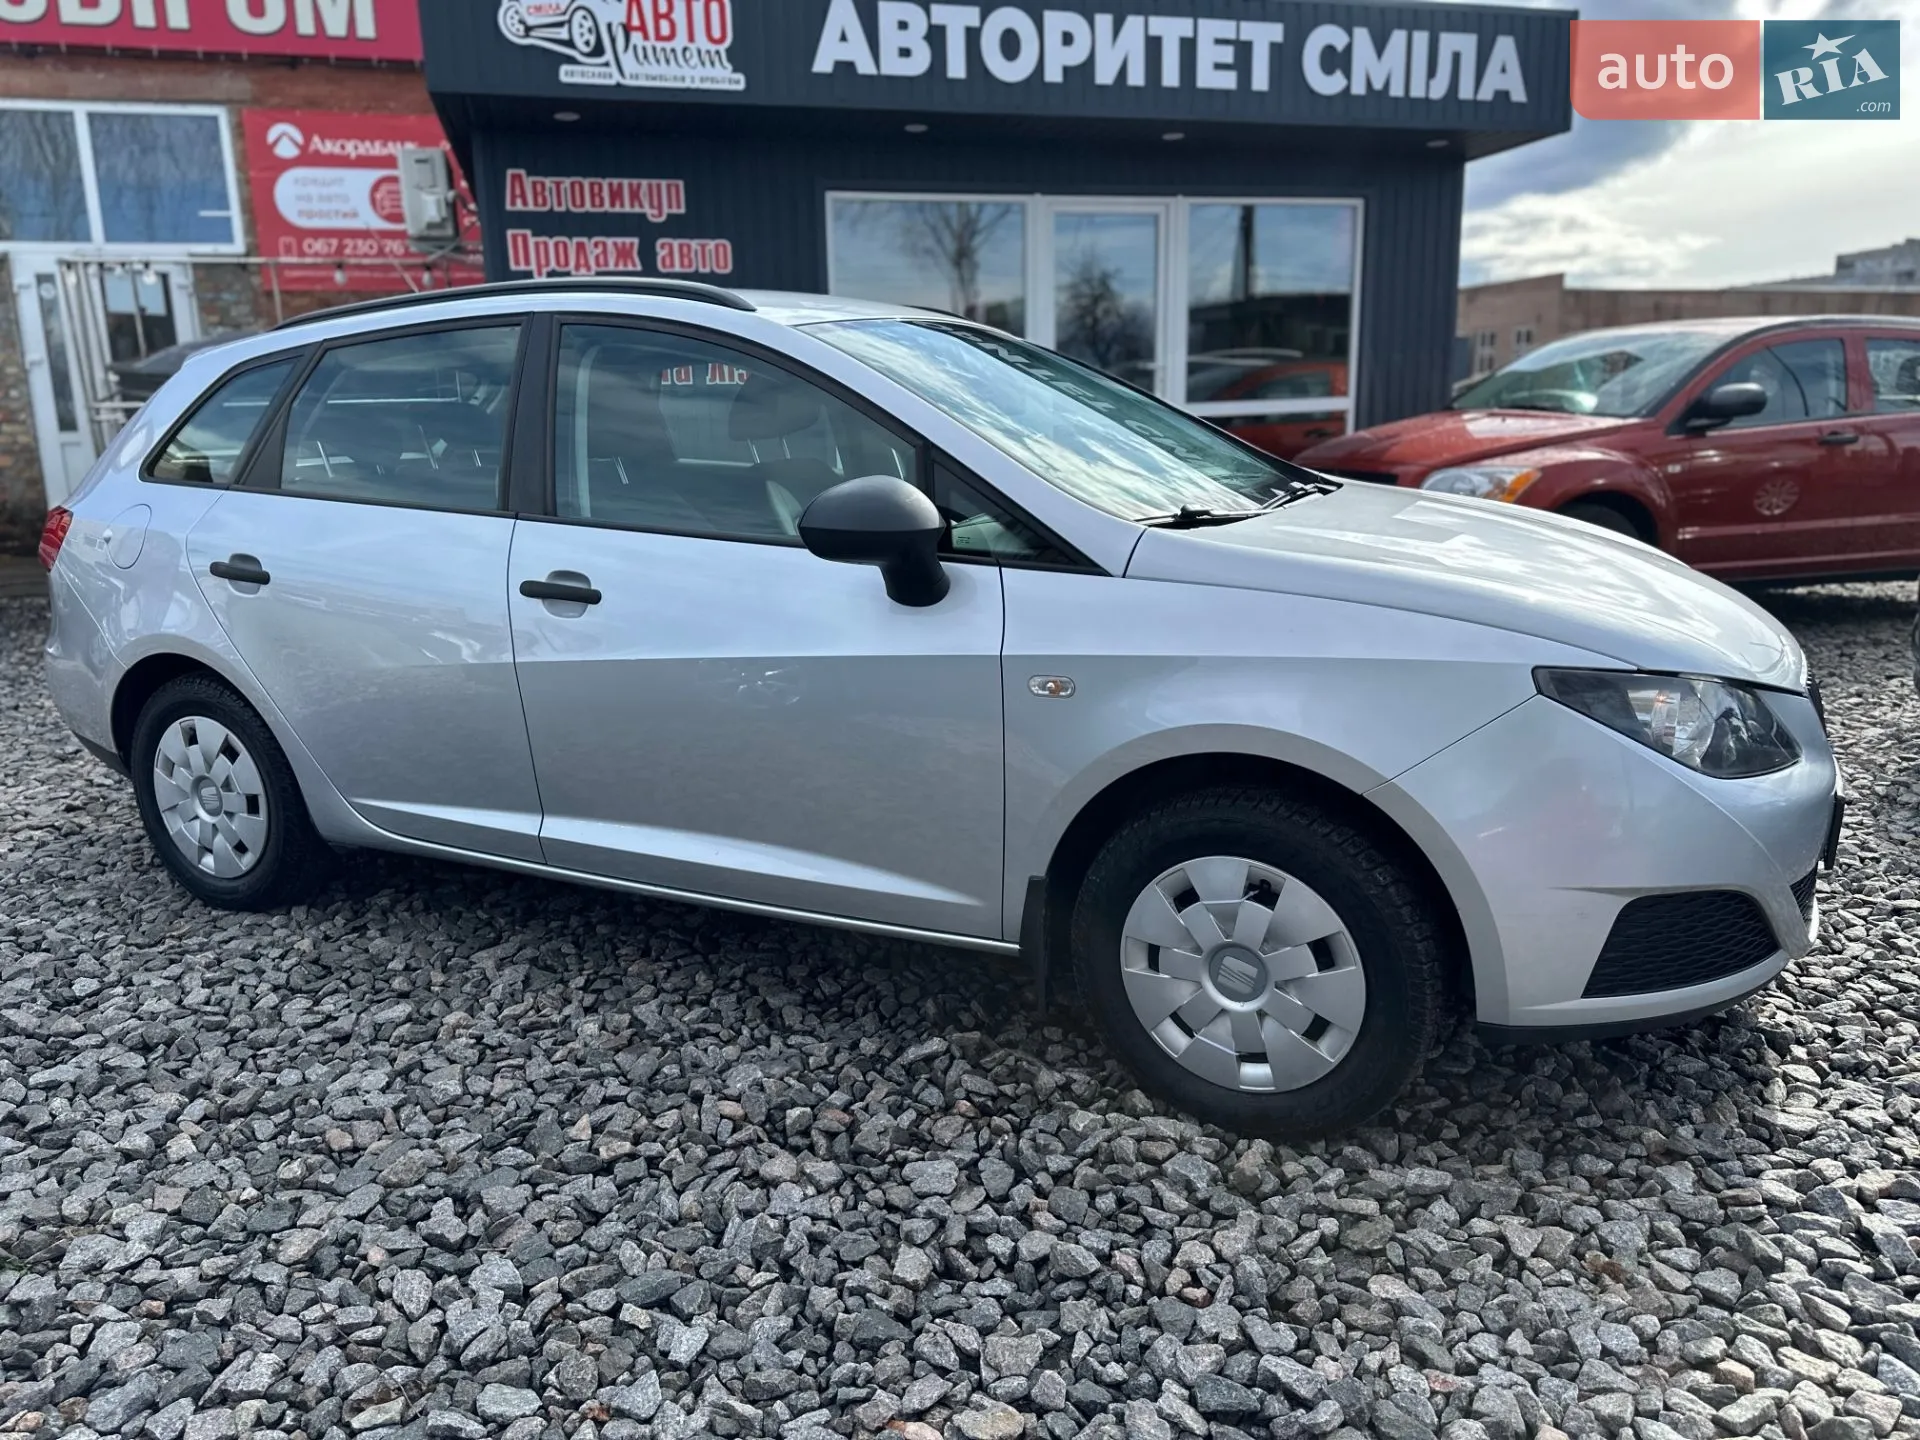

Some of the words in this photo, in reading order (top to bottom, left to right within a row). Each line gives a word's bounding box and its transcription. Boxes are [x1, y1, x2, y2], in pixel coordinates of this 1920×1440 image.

[625, 0, 728, 45] АВТО
[812, 0, 1284, 92] АВТОРИТЕТ
[1302, 23, 1528, 102] СМІЛА
[506, 169, 685, 221] Автовикуп
[303, 238, 338, 255] 067
[343, 239, 378, 255] 230
[507, 229, 642, 277] Продаж
[656, 238, 732, 273] авто
